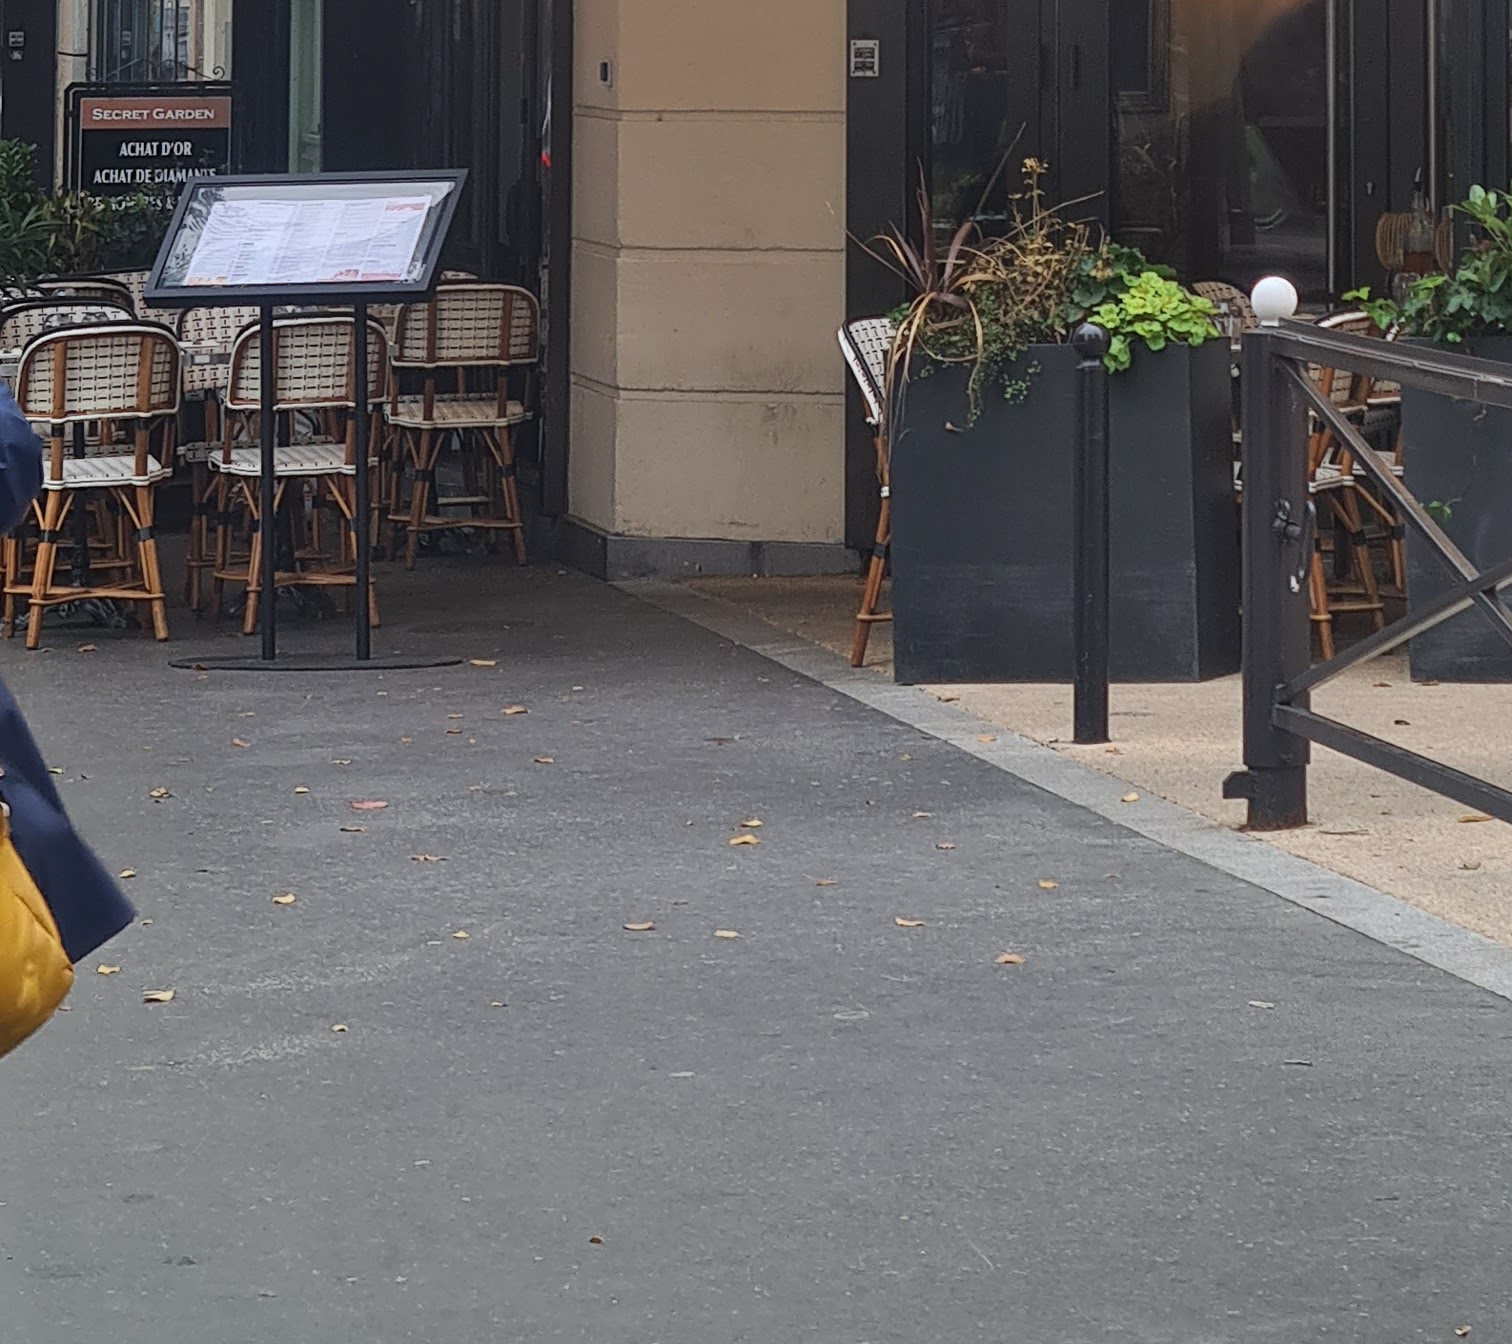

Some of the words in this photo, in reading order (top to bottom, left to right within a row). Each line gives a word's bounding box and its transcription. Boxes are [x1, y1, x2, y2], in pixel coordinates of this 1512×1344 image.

[92, 108, 150, 120] SECRET
[152, 108, 215, 120] GARDEN
[119, 142, 159, 156] ACHAT
[161, 141, 193, 156] D'OR
[93, 169, 134, 184] ACHAT
[136, 169, 151, 184] DE
